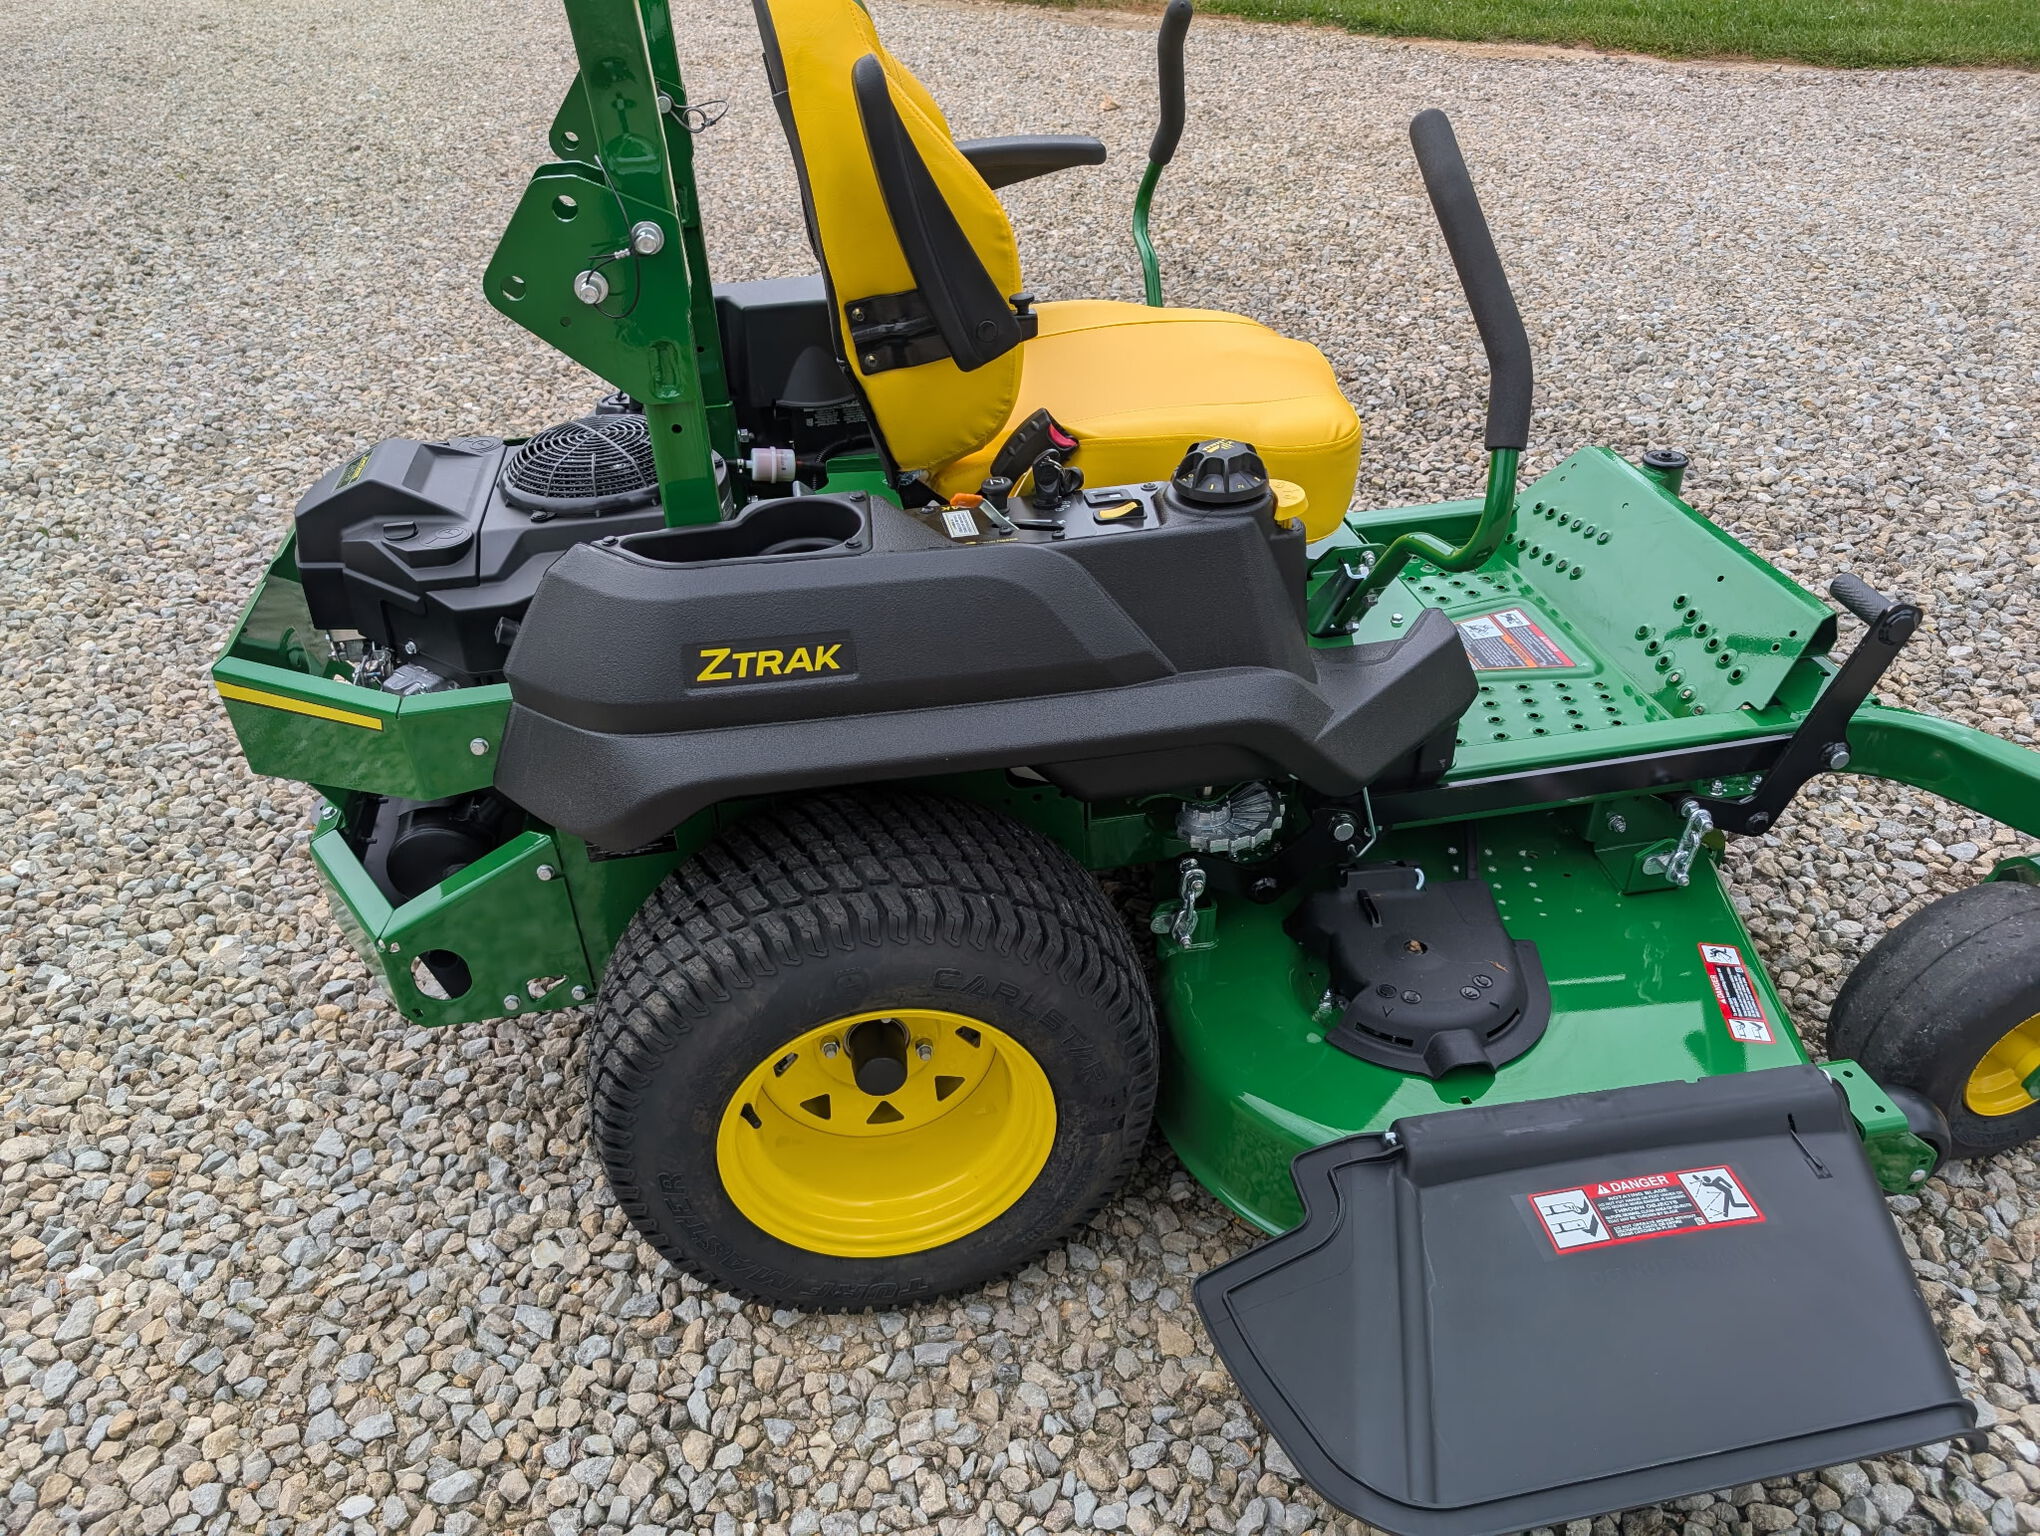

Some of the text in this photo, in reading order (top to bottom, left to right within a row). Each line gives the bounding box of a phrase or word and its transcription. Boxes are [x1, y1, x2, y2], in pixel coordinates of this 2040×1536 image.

[697, 643, 843, 682] ZTRAK
[1709, 974, 1725, 999] DANGER
[932, 967, 1104, 1084] CARLSTAR
[1608, 1192, 1643, 1200] ROTATING
[1610, 1175, 1669, 1192] DANGER
[657, 1171, 929, 1298] TURF MASTER
